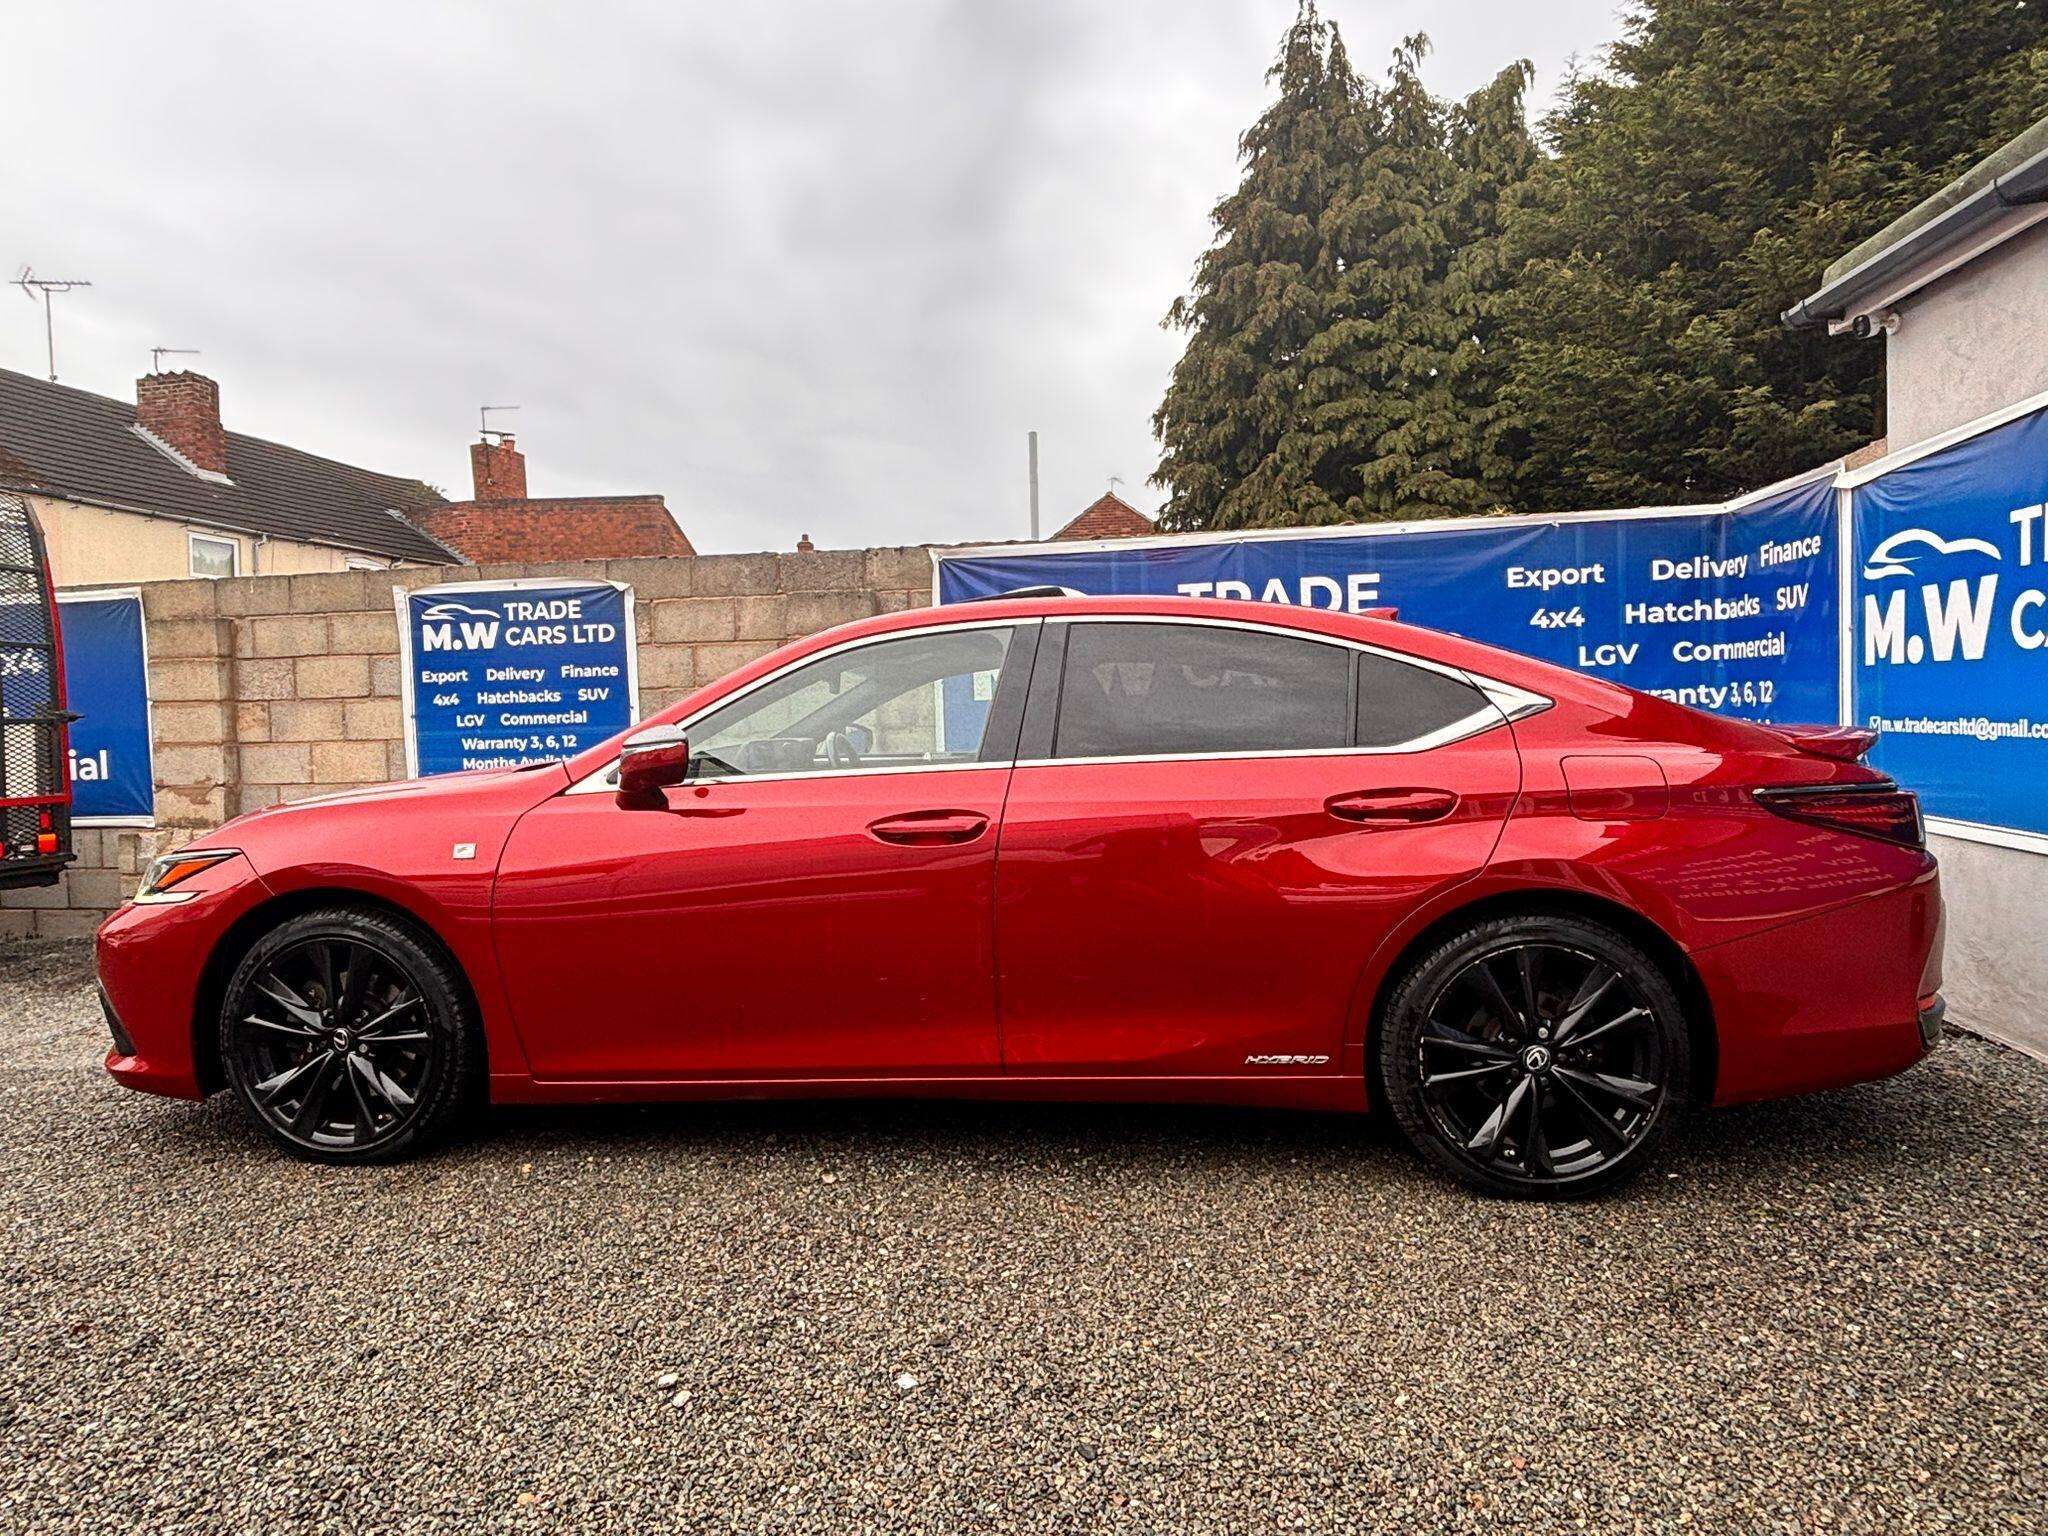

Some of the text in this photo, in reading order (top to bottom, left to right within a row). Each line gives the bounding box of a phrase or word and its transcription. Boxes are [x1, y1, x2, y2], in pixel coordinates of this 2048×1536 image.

[1507, 535, 1821, 590] Export Delivery Finance
[504, 600, 582, 621] TRADE
[1530, 583, 1809, 629] 4x4 Hatchbacks SUV
[1864, 573, 1999, 667] M.W
[422, 622, 499, 651] M.W
[505, 624, 616, 646] CARS LTD
[1579, 631, 1785, 667] LGV Commercial
[421, 664, 619, 684] Export Delivery Finance
[433, 688, 609, 706] 4x4 Hatchbacks SUV
[1759, 680, 1773, 703] 12
[456, 711, 587, 727] LGV Commercial
[461, 738, 528, 751] Warranty
[562, 735, 577, 747] 12
[68, 749, 109, 781] ial
[463, 757, 517, 770] Months
[1244, 1055, 1330, 1064] HYBRID
